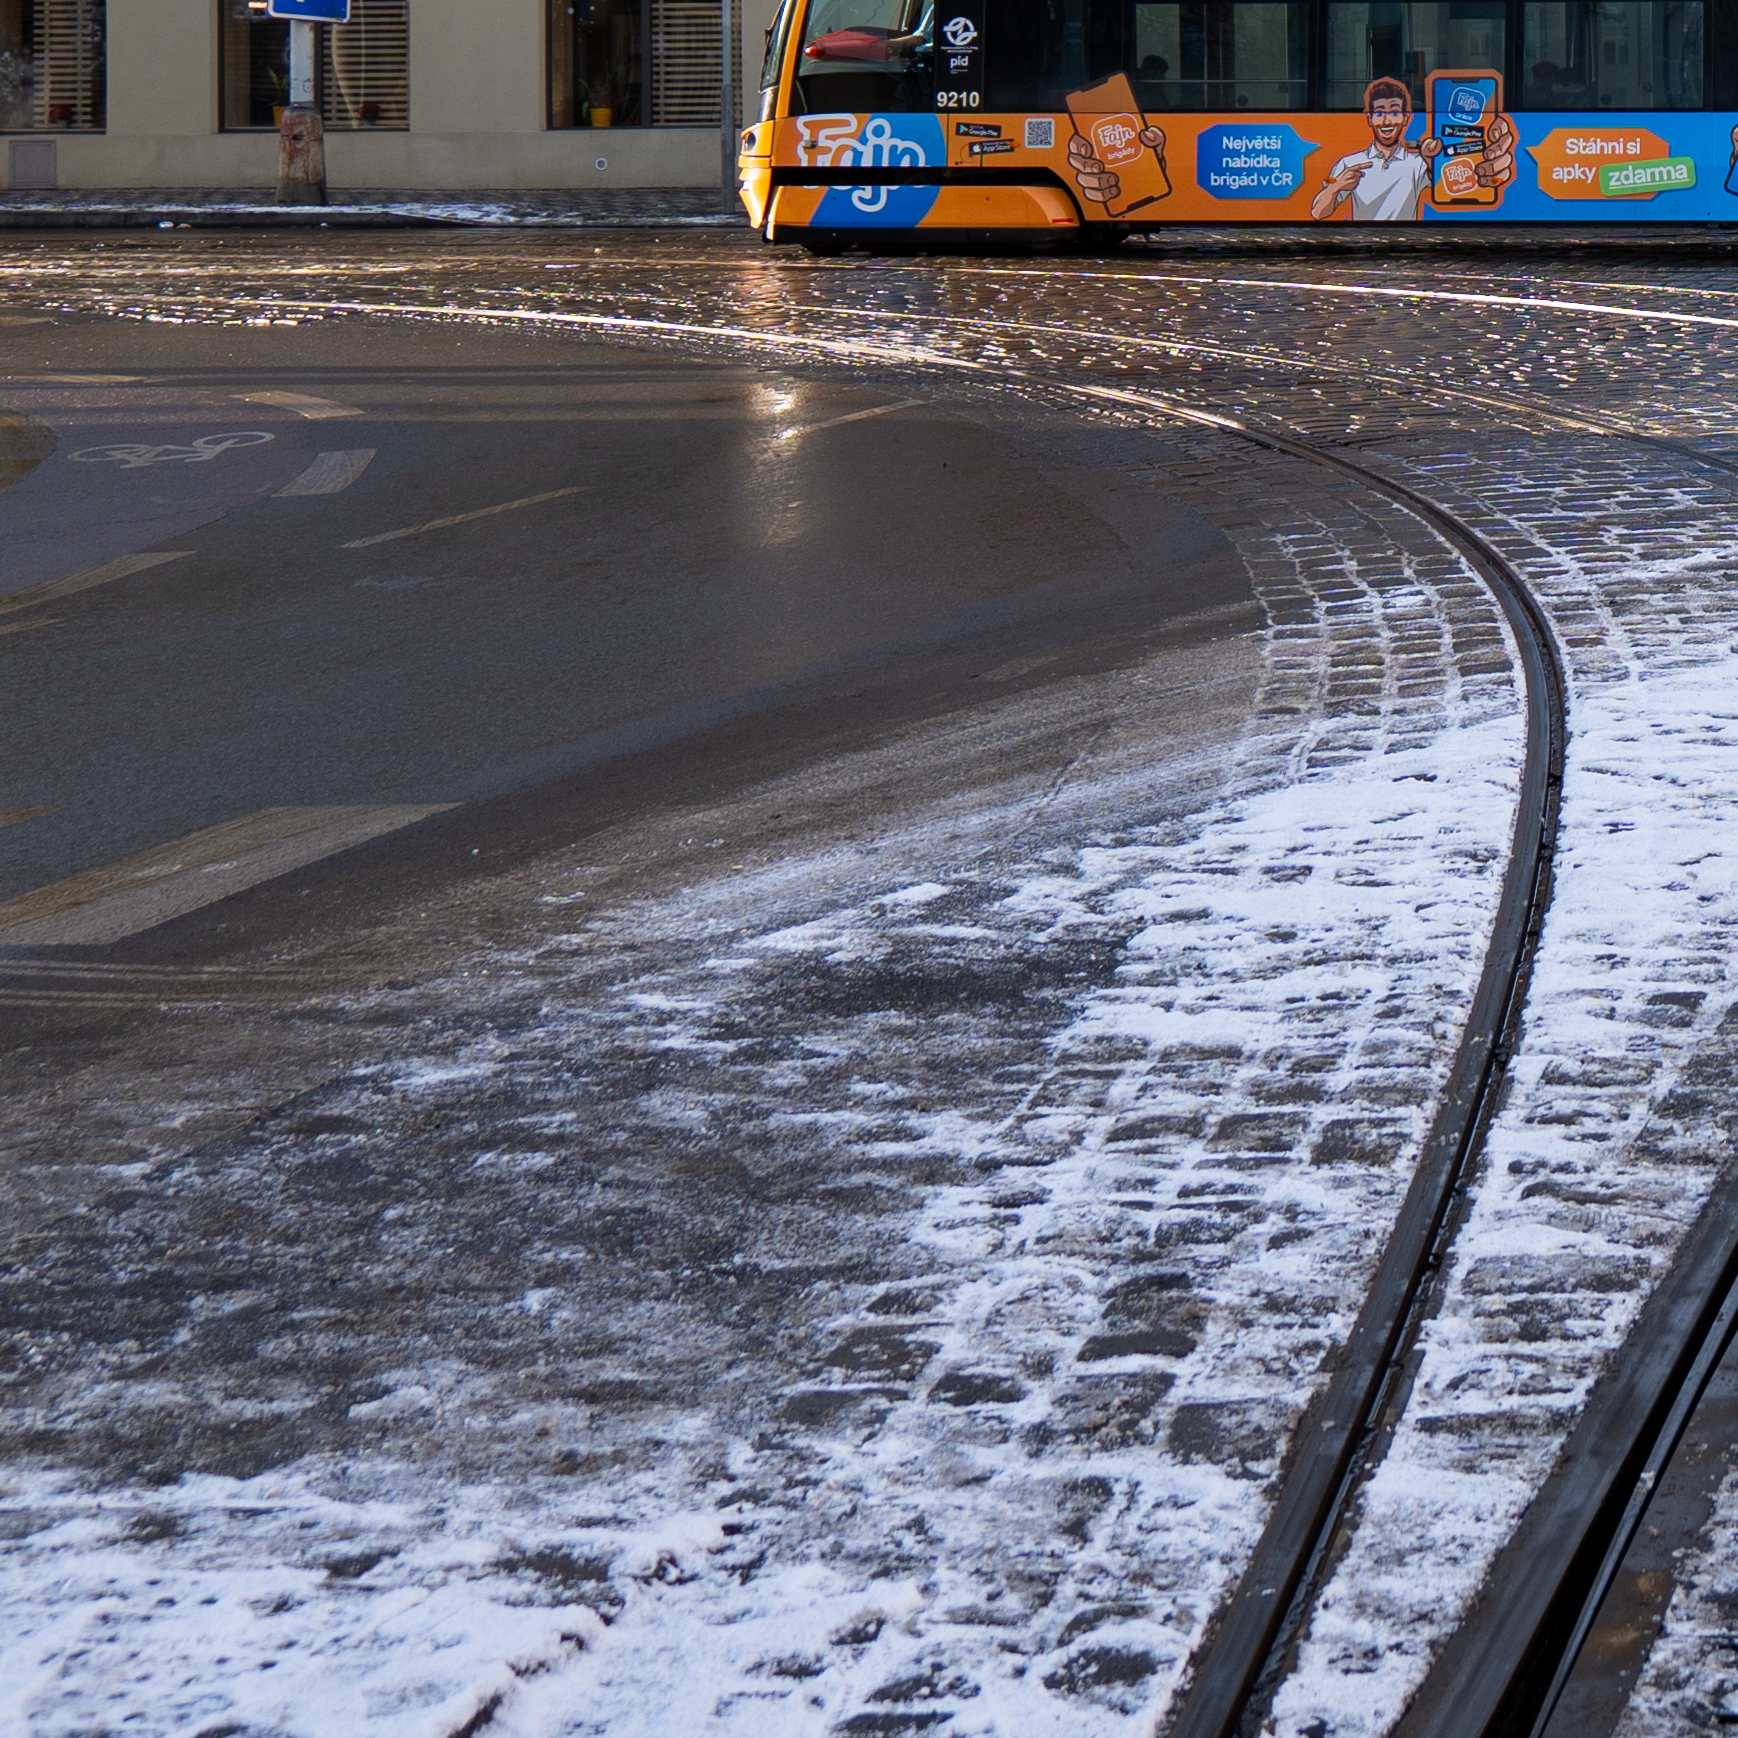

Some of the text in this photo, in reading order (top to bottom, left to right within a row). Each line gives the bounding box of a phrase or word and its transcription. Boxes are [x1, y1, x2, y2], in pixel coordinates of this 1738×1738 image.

[950, 56, 969, 68] pid
[937, 91, 980, 107] 9210
[1097, 123, 1135, 148] Fajn
[1222, 135, 1282, 152] Největší
[1565, 137, 1641, 155] Stáhni si
[1222, 153, 1281, 168] nabídka
[1210, 170, 1293, 189] brigád v ČR
[1552, 163, 1688, 187] apky zdarma
